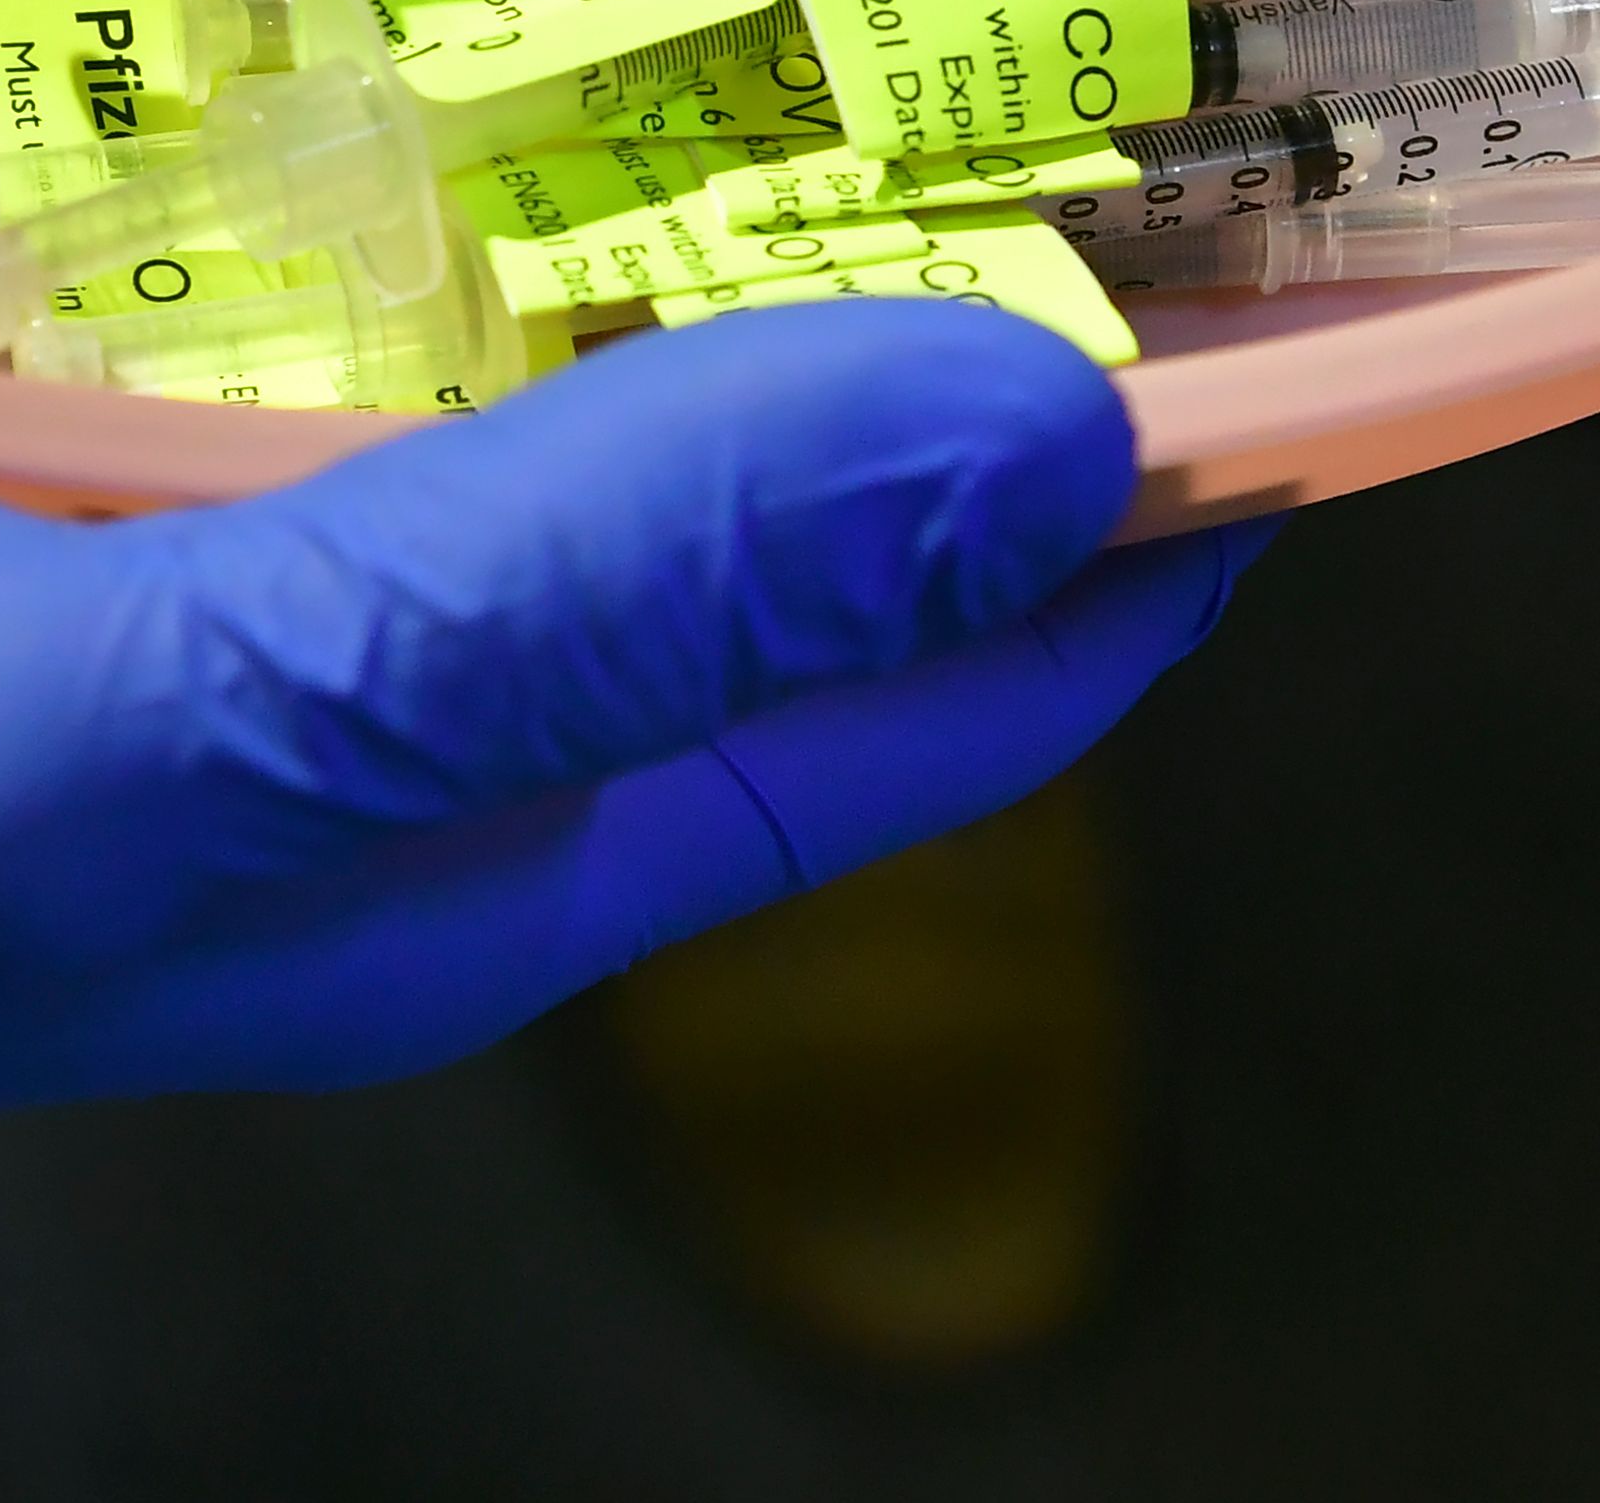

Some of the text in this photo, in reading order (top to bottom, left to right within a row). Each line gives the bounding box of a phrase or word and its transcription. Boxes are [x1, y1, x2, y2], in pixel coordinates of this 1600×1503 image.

[0, 41, 45, 130] Must
[74, 9, 145, 139] Pfiz
[982, 5, 1029, 135] within
[1061, 6, 1118, 123] CO
[700, 108, 736, 126] 6
[1397, 134, 1439, 186] 0.2
[1481, 119, 1522, 169] 0.1
[499, 169, 576, 247] EN6201
[634, 174, 672, 208] use
[1142, 181, 1185, 231] 0.5
[1226, 166, 1270, 216] 0.4
